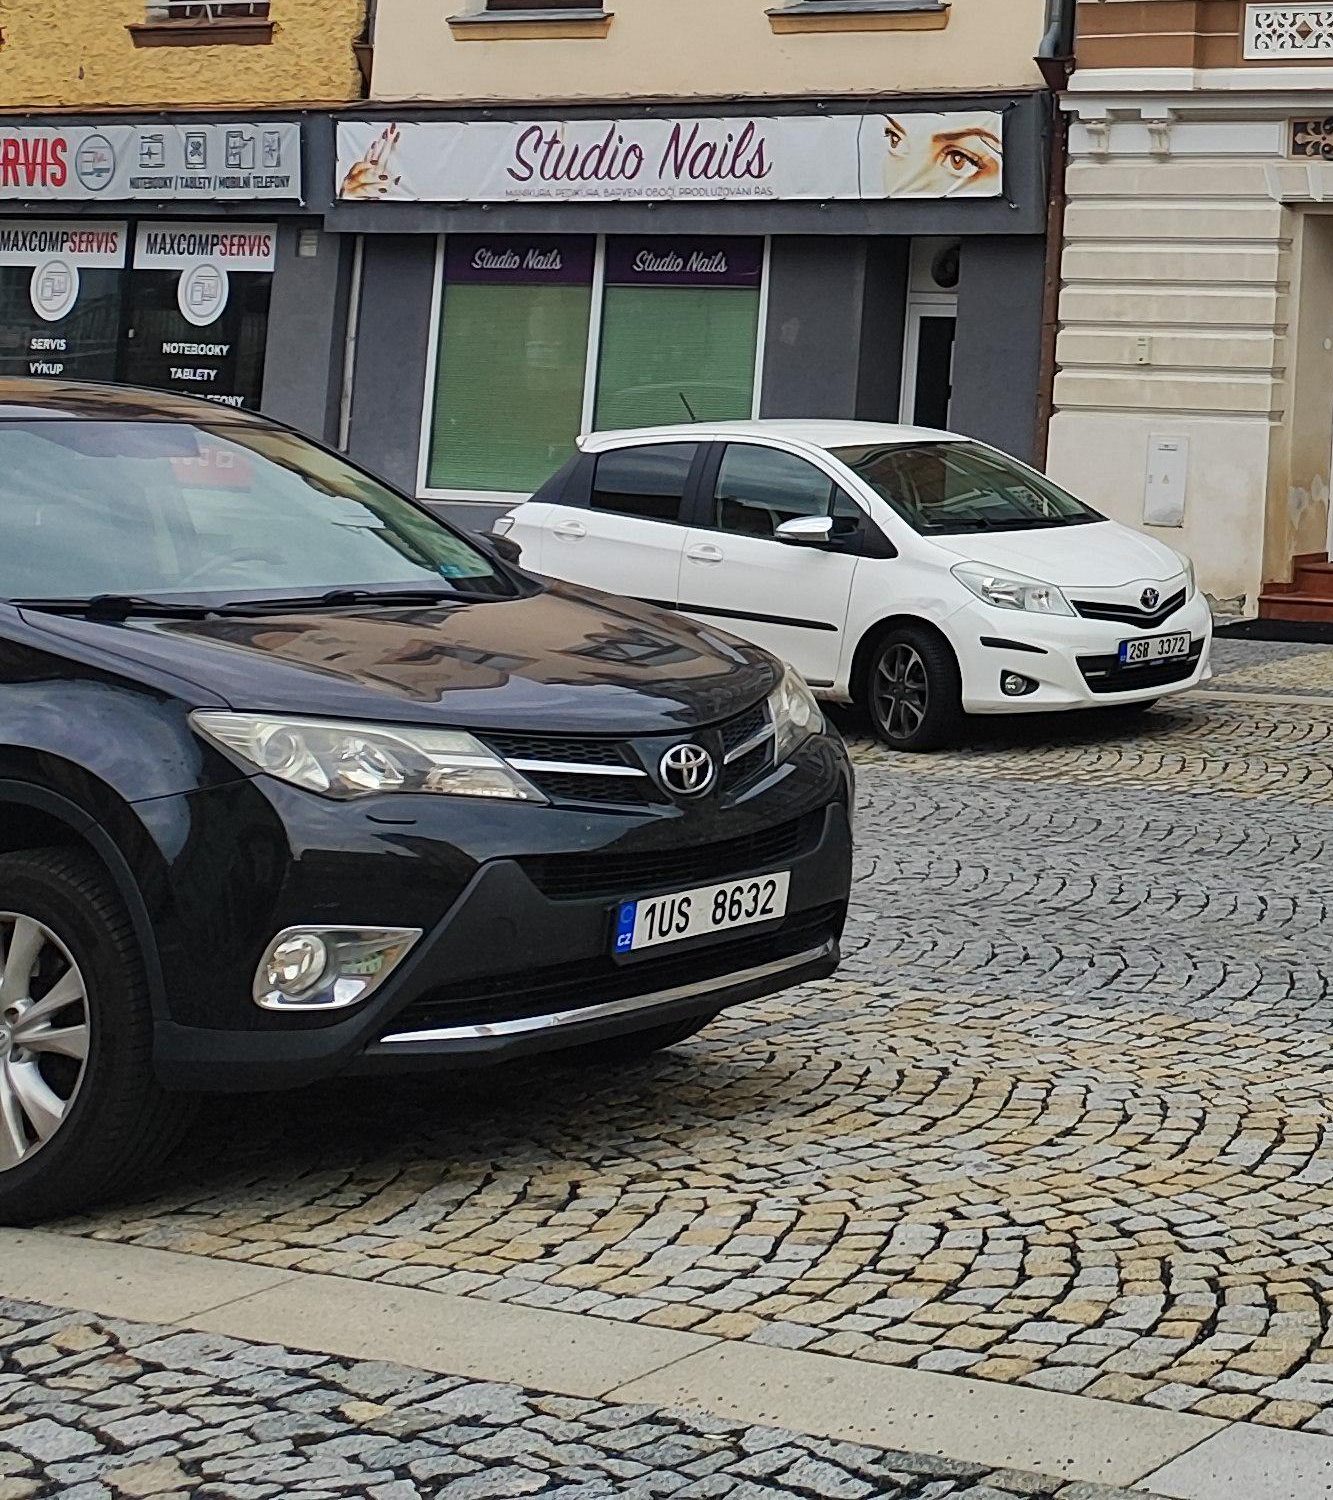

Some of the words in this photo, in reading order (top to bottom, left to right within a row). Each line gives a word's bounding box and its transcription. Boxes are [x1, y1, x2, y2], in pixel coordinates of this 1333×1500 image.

[0, 136, 68, 187] RVIS
[507, 122, 645, 181] Studio
[658, 120, 773, 180] Nails
[0, 230, 119, 254] MAXCOMPSERVIS
[145, 232, 272, 257] MAXCOMPSERVIS
[471, 248, 520, 269] Studio
[522, 248, 563, 270] Nails
[632, 250, 683, 272] Studio
[686, 251, 728, 273] Nails
[30, 338, 67, 351] SERVIS
[162, 342, 230, 356] NOTEBOOKY
[29, 359, 64, 375] VÝKUP
[169, 367, 218, 381] TABLETY
[1157, 636, 1186, 655] 3372
[643, 896, 692, 941] 1US
[711, 879, 777, 926] 8632
[617, 932, 632, 947] CZ
